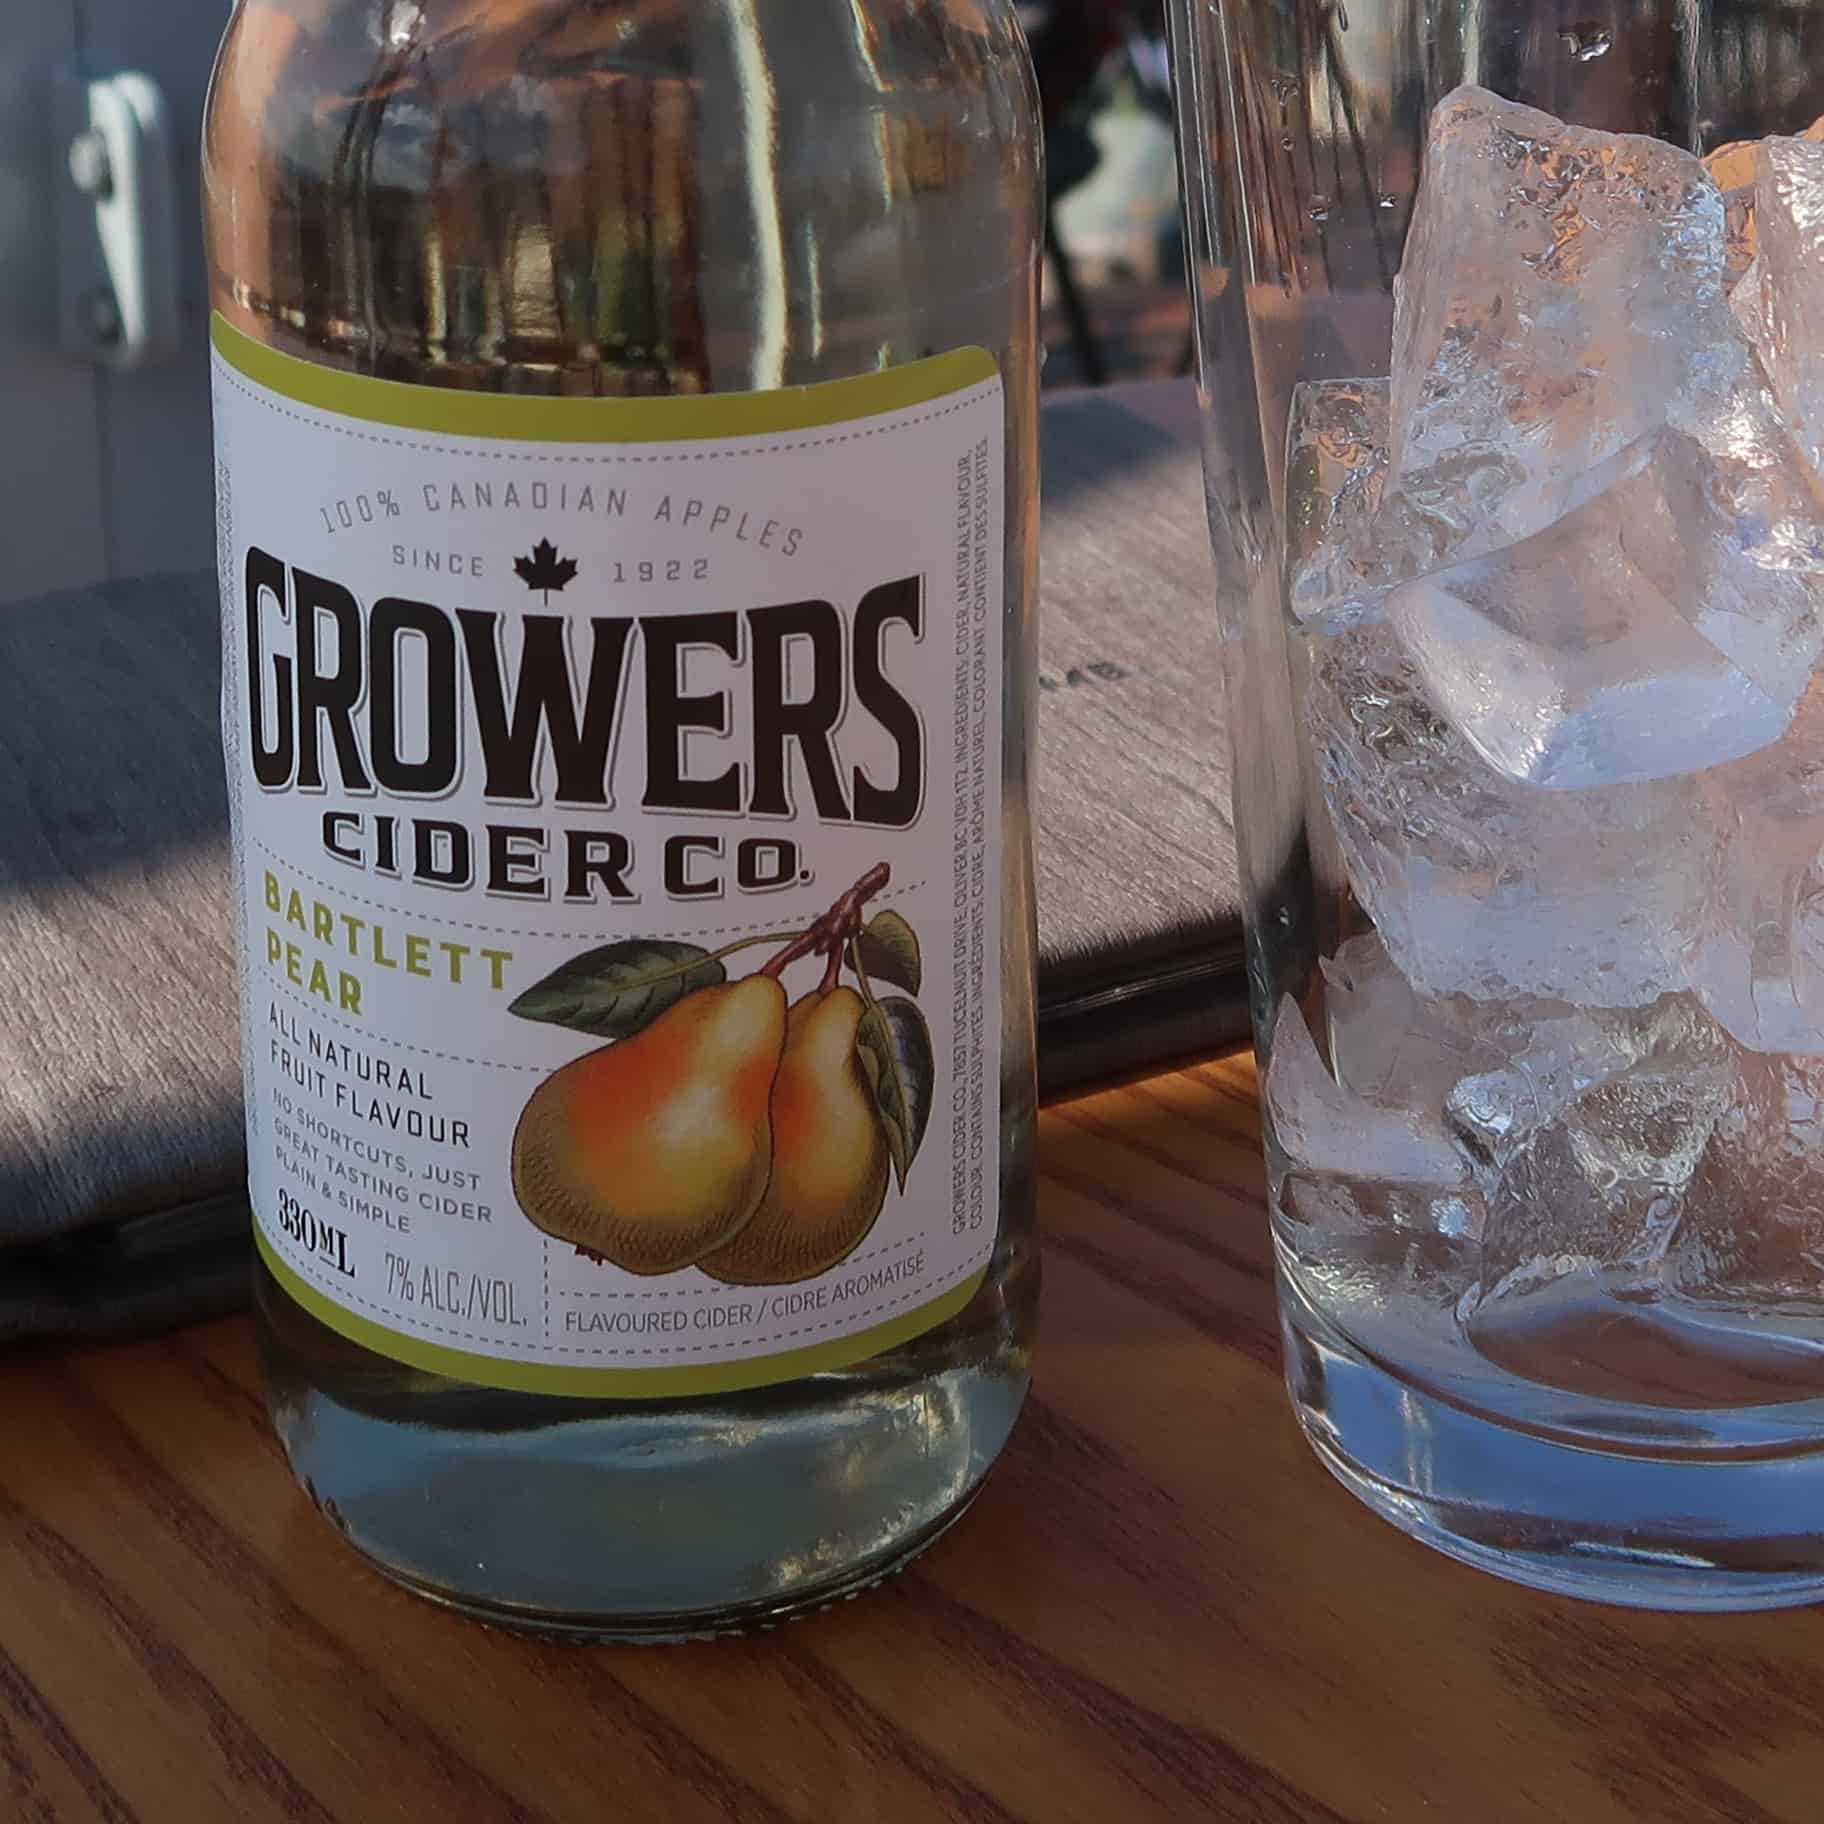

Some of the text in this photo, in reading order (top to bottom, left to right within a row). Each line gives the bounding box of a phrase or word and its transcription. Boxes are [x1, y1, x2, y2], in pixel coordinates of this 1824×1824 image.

[319, 480, 806, 559] 100% CANADIAN APPLES
[391, 544, 710, 583] SINCE 1922
[244, 544, 925, 830] GROWERS
[321, 810, 812, 904] CIDER CO.
[265, 871, 512, 991] BARTLETT
[266, 927, 363, 1016] PEAR
[270, 1001, 432, 1100] ALL NATURAL
[271, 1040, 469, 1148] FRUIT FLAVOUR
[274, 1087, 480, 1191] NO SHORTCUTS, JUST
[275, 1117, 492, 1223] GREAT TASTING CIDER
[276, 1148, 411, 1233] PLAIN & SIMPLE
[952, 1160, 967, 1235] GROWERS
[385, 1252, 414, 1301] 7%
[565, 1248, 926, 1332] FLAVOURED CIDER / CIDRE AROMATISÉ
